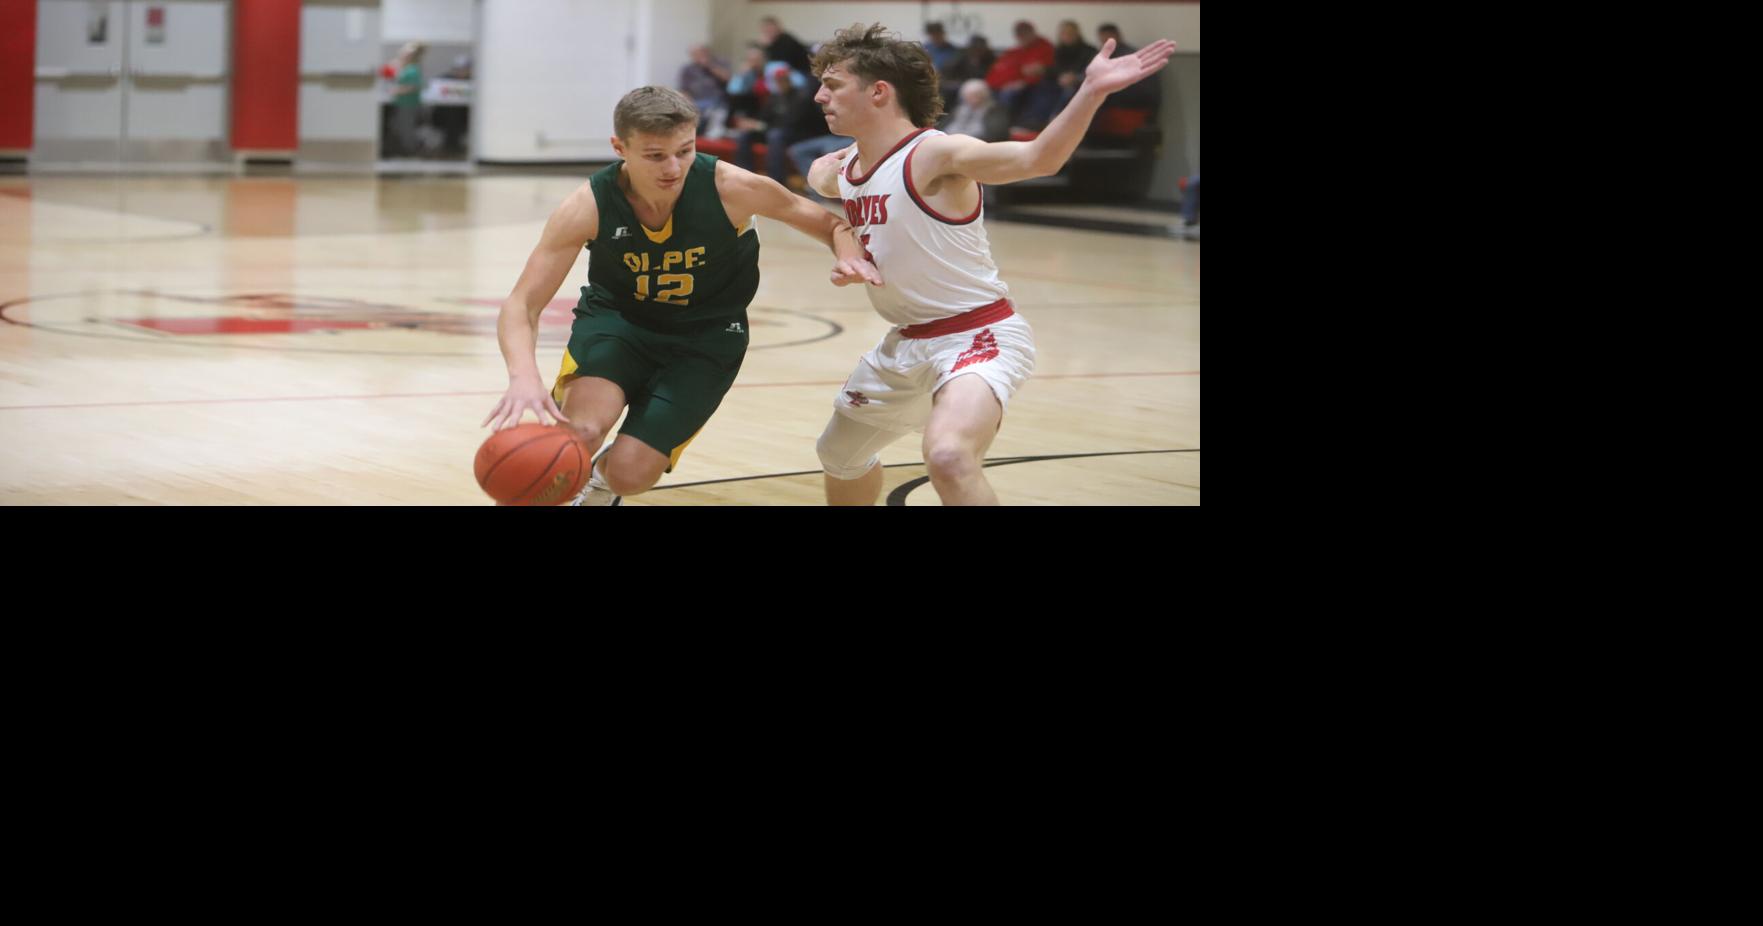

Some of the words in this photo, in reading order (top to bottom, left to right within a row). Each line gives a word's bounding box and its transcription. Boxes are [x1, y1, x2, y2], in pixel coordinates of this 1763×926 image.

[843, 193, 891, 227] OLVES
[624, 246, 706, 272] OLPE
[634, 273, 694, 306] 12
